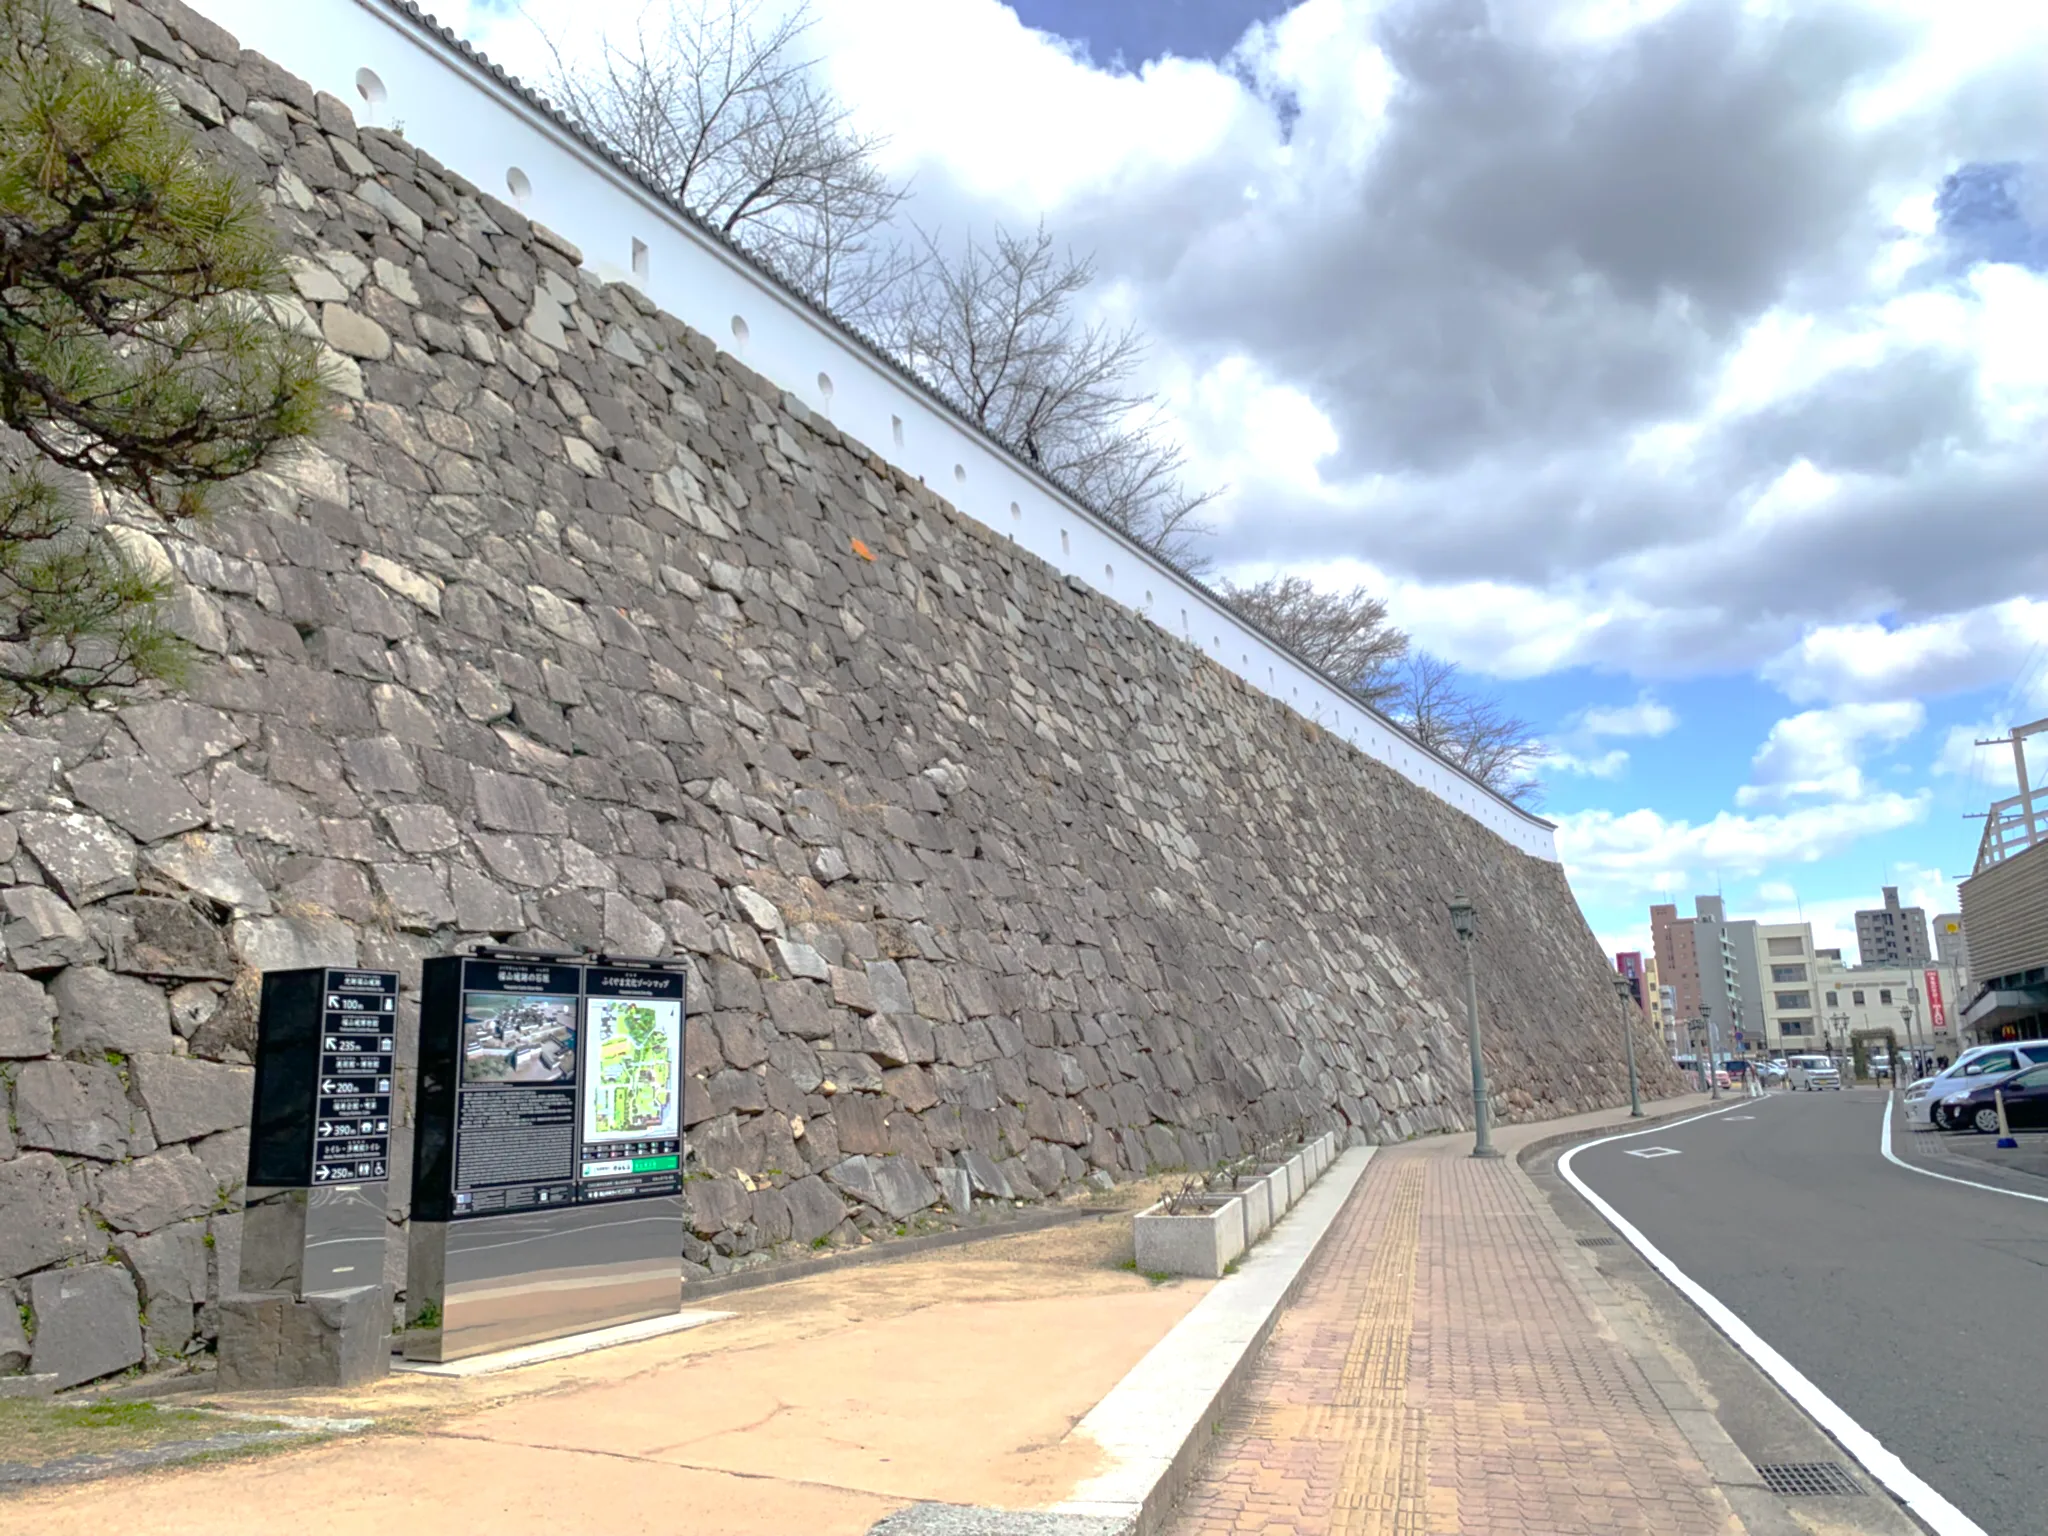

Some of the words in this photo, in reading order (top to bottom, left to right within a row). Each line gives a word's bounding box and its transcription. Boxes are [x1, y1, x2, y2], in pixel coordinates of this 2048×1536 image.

[342, 999, 364, 1010] 100m
[339, 1040, 361, 1051] 235m
[336, 1083, 359, 1093] 200m
[333, 1125, 356, 1136] 390m
[330, 1167, 353, 1179] 250m
